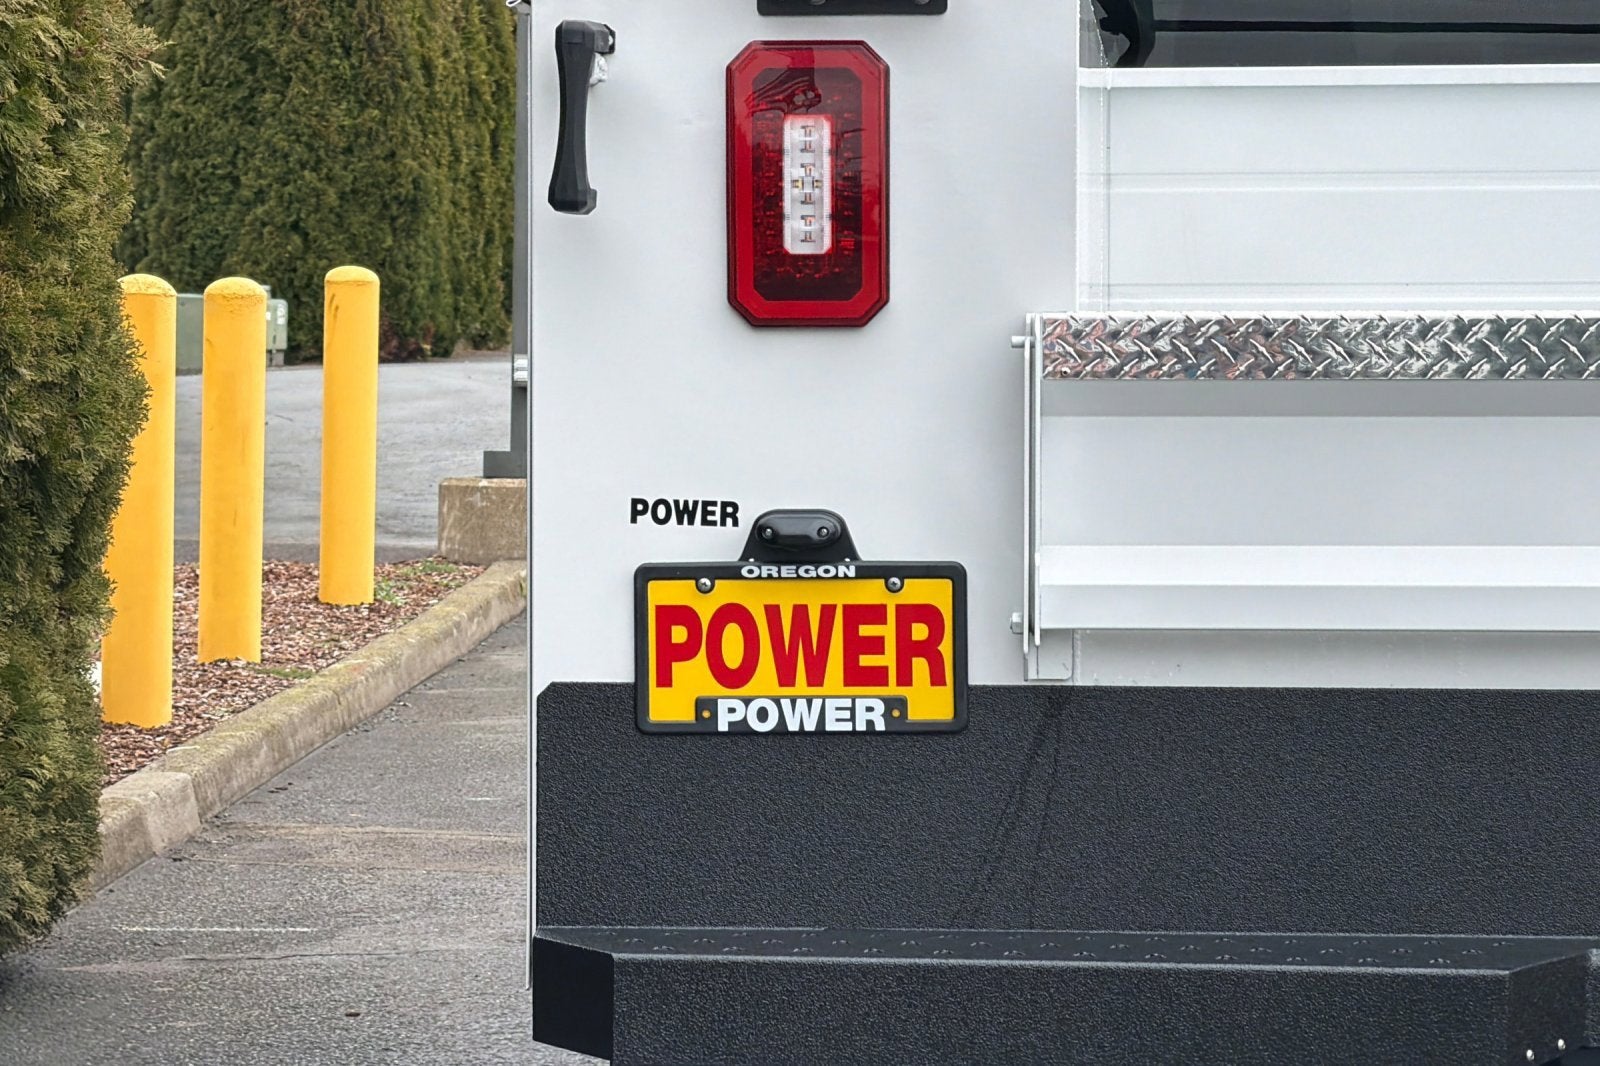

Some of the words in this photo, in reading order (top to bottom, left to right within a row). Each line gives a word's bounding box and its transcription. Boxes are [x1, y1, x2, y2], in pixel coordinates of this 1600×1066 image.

[630, 497, 739, 527] POWER
[740, 564, 857, 578] OREGON
[655, 602, 948, 689] POWER
[717, 697, 886, 732] POWER
